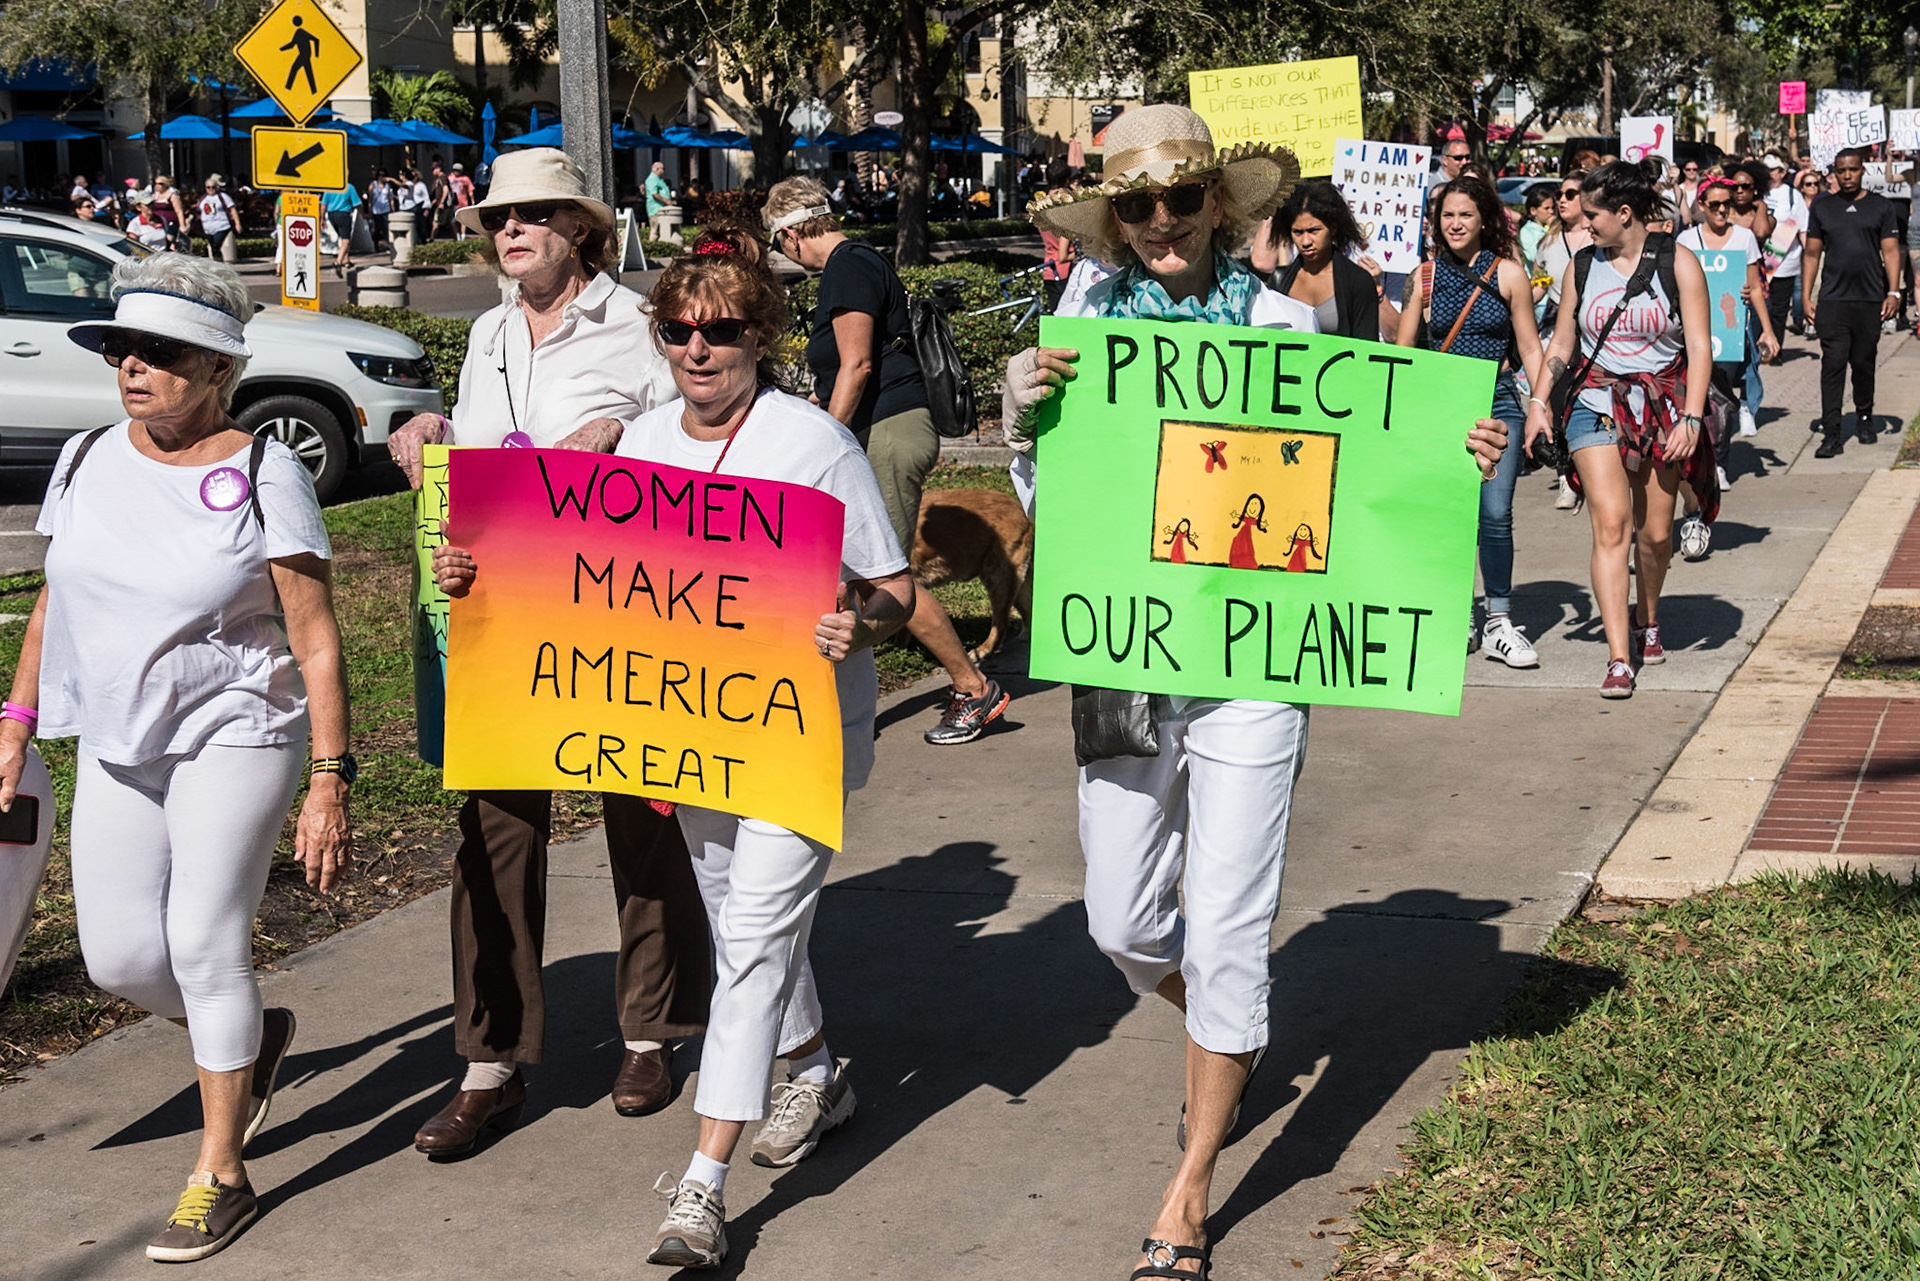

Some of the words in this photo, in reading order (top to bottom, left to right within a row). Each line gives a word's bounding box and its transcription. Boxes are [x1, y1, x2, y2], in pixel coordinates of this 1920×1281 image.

[1249, 72, 1281, 88] NOT
[1287, 68, 1321, 82] OUR
[1313, 82, 1356, 104] THAT
[1848, 110, 1868, 127] EE
[1847, 120, 1884, 145] UGS!
[1361, 144, 1367, 162] I
[1378, 146, 1408, 166] AM
[1343, 168, 1424, 189] WOMAN!
[288, 196, 313, 206] STATE
[292, 206, 309, 214] LAW
[1347, 200, 1383, 216] EAR
[1395, 203, 1421, 219] ME
[290, 227, 313, 240] STOP
[1105, 333, 1414, 431] PROTECT
[536, 455, 785, 550] WOMEN
[573, 552, 750, 630] MAKE
[1061, 593, 1182, 672] OUR
[1225, 598, 1434, 692] PLANET
[531, 641, 805, 735] AMERICA
[554, 731, 746, 800] GREAT
